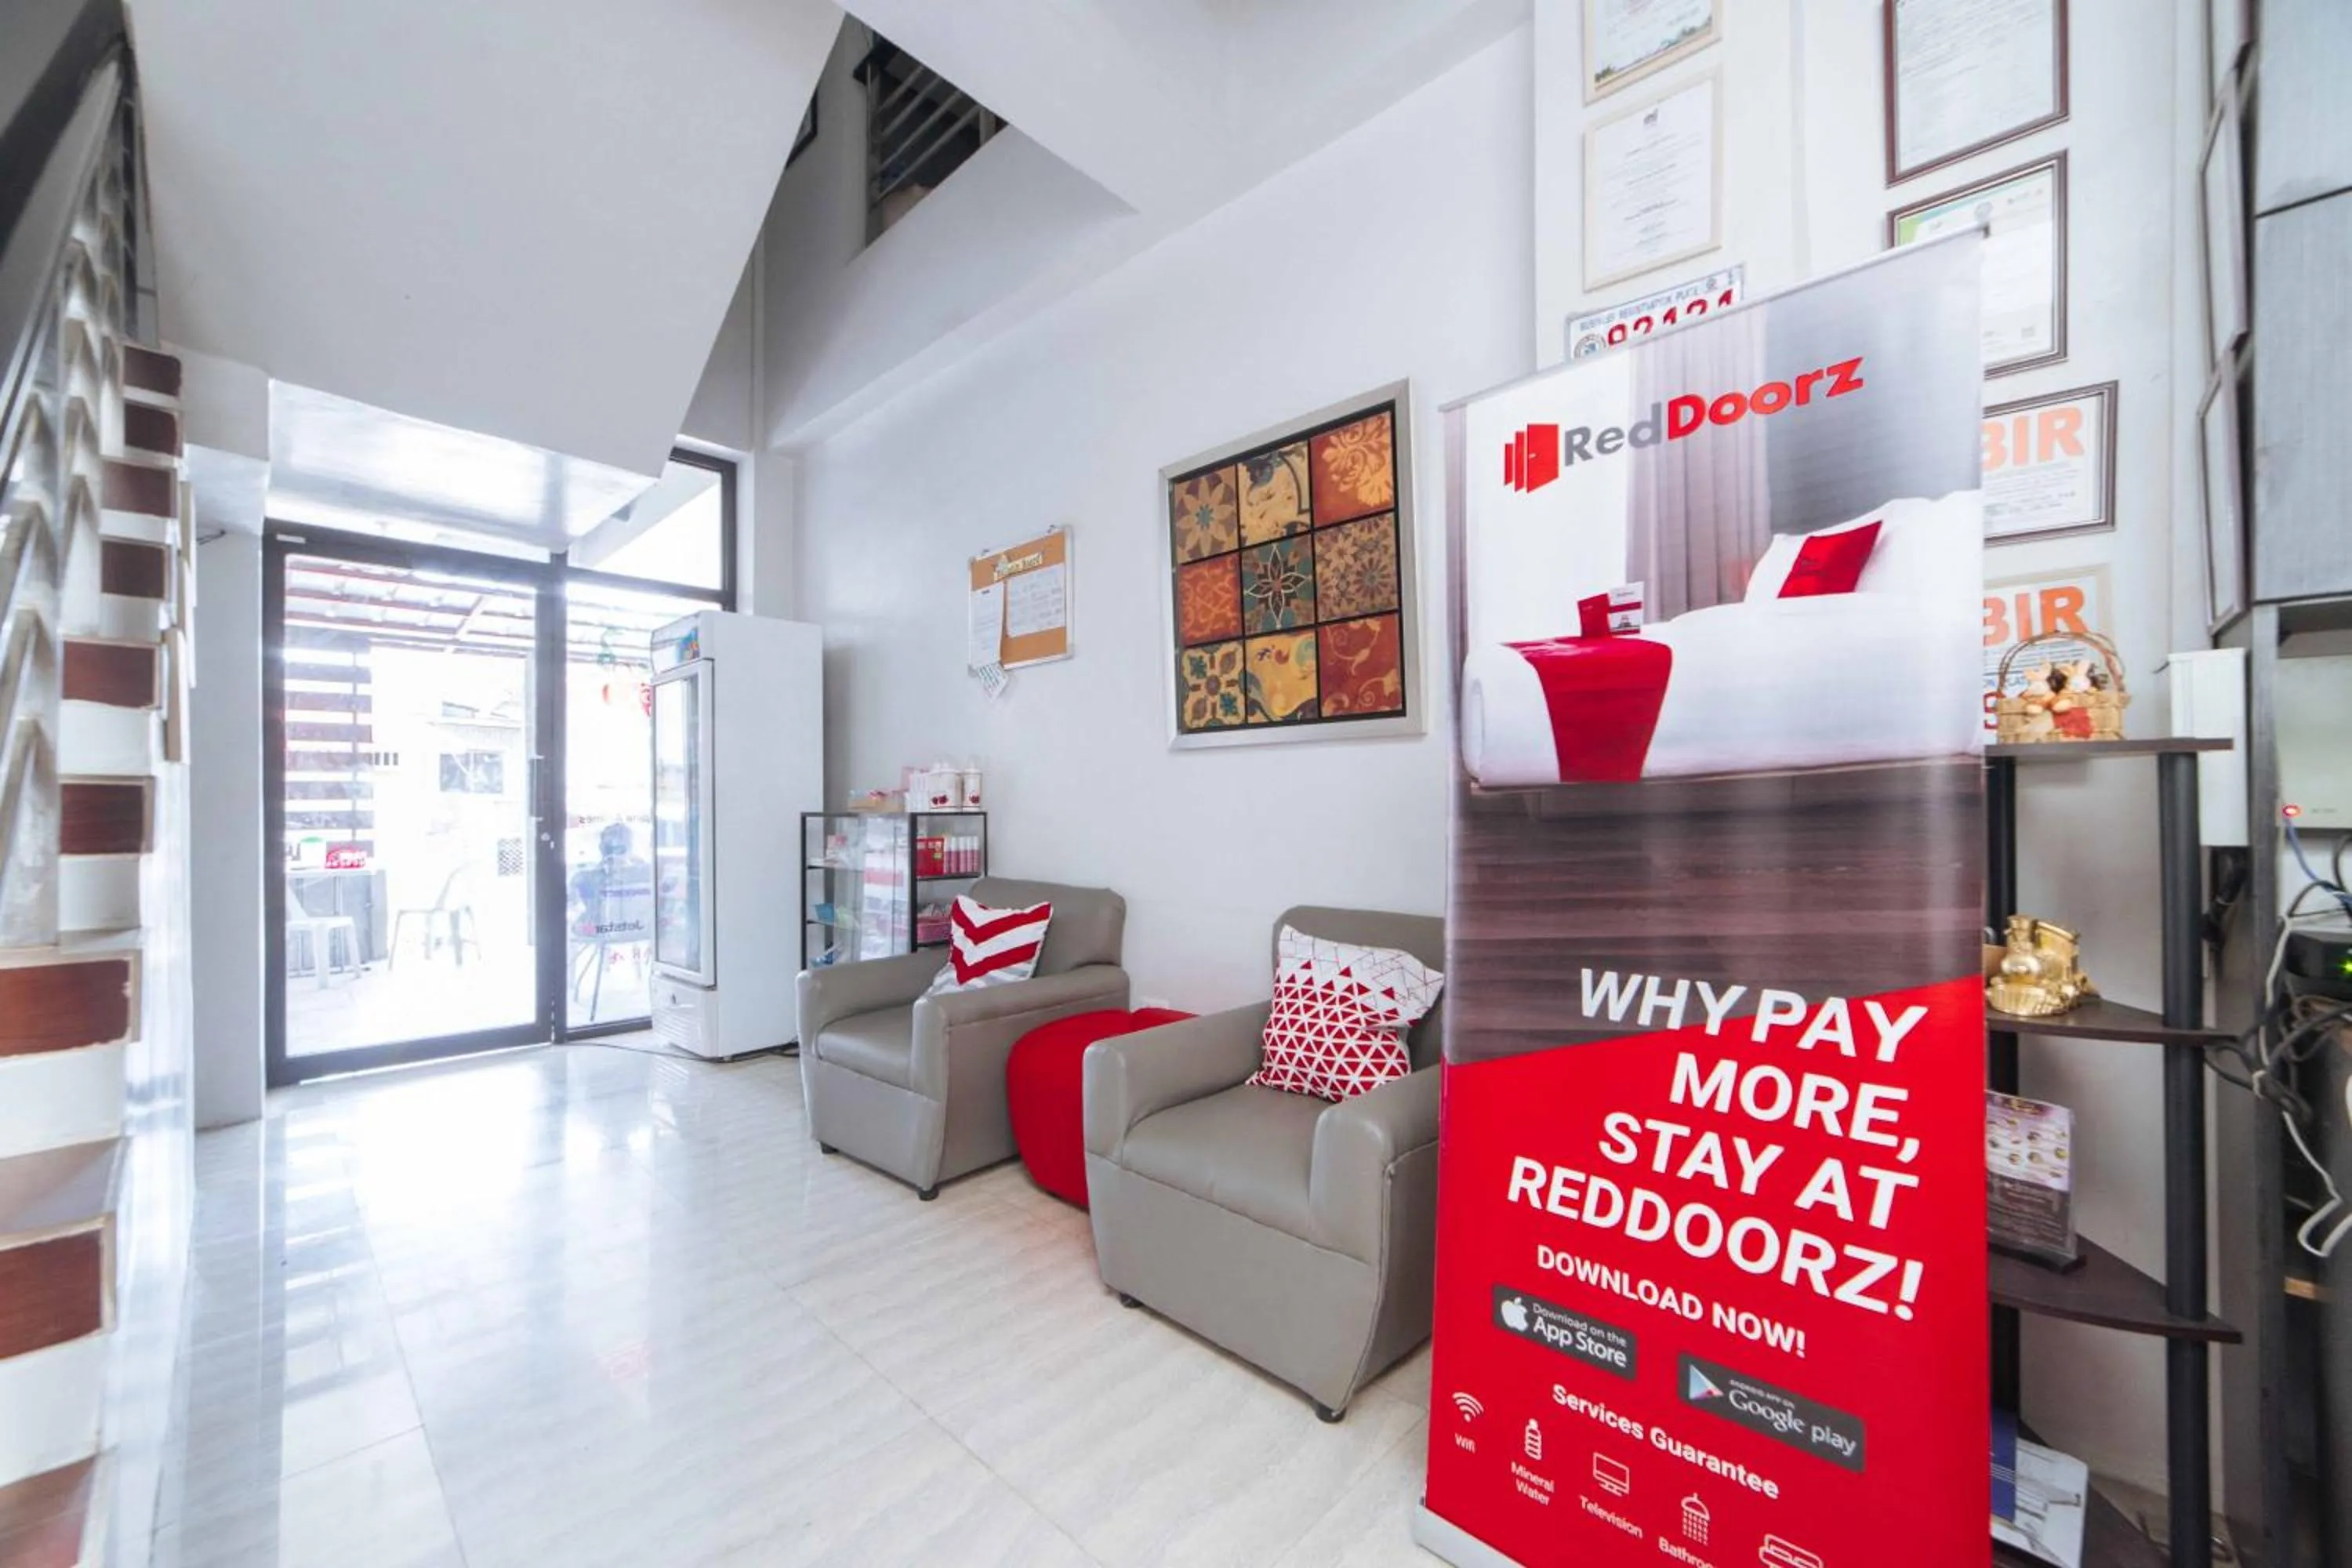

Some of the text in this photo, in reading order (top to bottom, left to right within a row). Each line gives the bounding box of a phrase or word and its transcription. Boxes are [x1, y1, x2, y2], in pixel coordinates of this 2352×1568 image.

[1564, 357, 1864, 466] RedDoorz
[1581, 967, 1929, 1062] WHY PAY
[1669, 1052, 1920, 1163] MORE,
[1599, 1112, 1784, 1196] STAY
[1794, 1157, 1919, 1230] AT
[1508, 1156, 1924, 1322] REDDOORZ!
[1533, 1302, 1628, 1348] Download on the
[1533, 1315, 1628, 1368] App Store
[1537, 1244, 1807, 1359] DOWNLOAD NOW!
[1454, 1433, 1475, 1454] Wifi
[1552, 1384, 1780, 1500] Services Guarantee
[1728, 1388, 1857, 1457] Google play
[1511, 1461, 1555, 1493] Mineral
[1515, 1479, 1549, 1505] Water
[1579, 1494, 1643, 1538] Television
